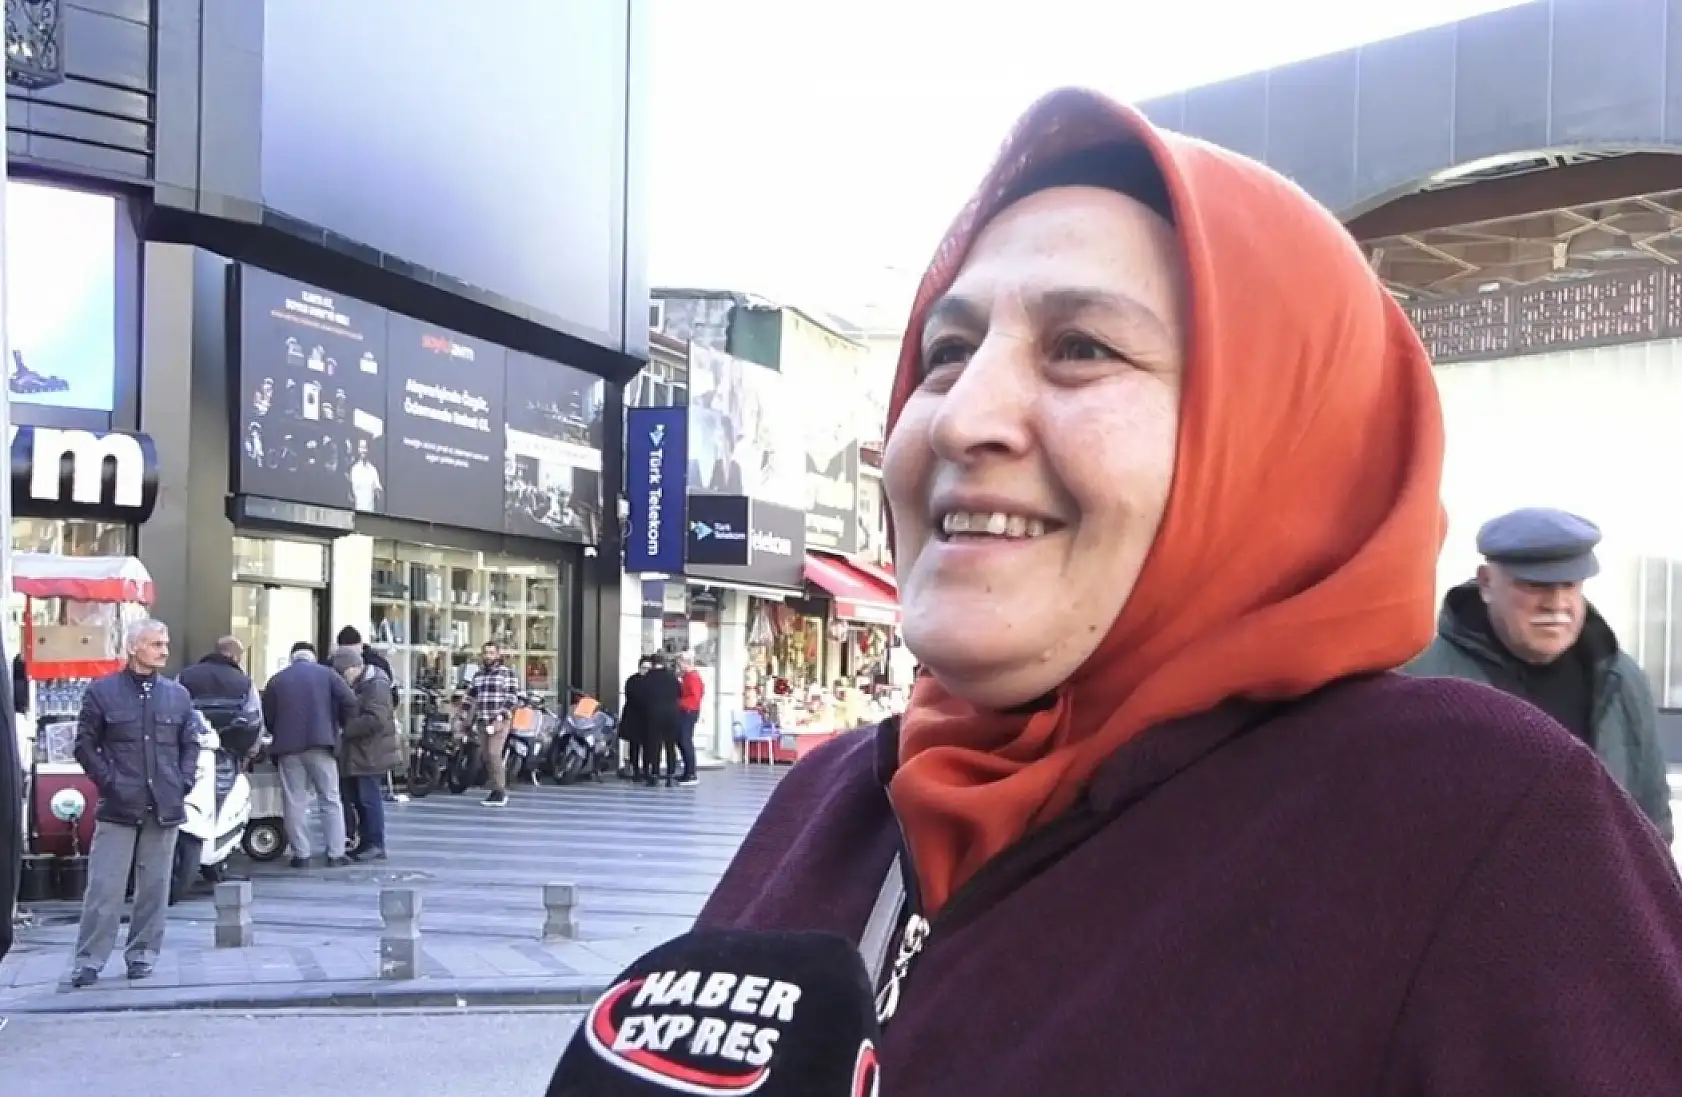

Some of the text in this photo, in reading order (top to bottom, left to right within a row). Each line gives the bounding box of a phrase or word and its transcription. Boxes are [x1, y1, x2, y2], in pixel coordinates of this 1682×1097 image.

[9, 425, 144, 508] m
[647, 448, 663, 556] Türk Telekom
[631, 970, 802, 1022] HABER
[612, 1013, 780, 1066] EXPRES
